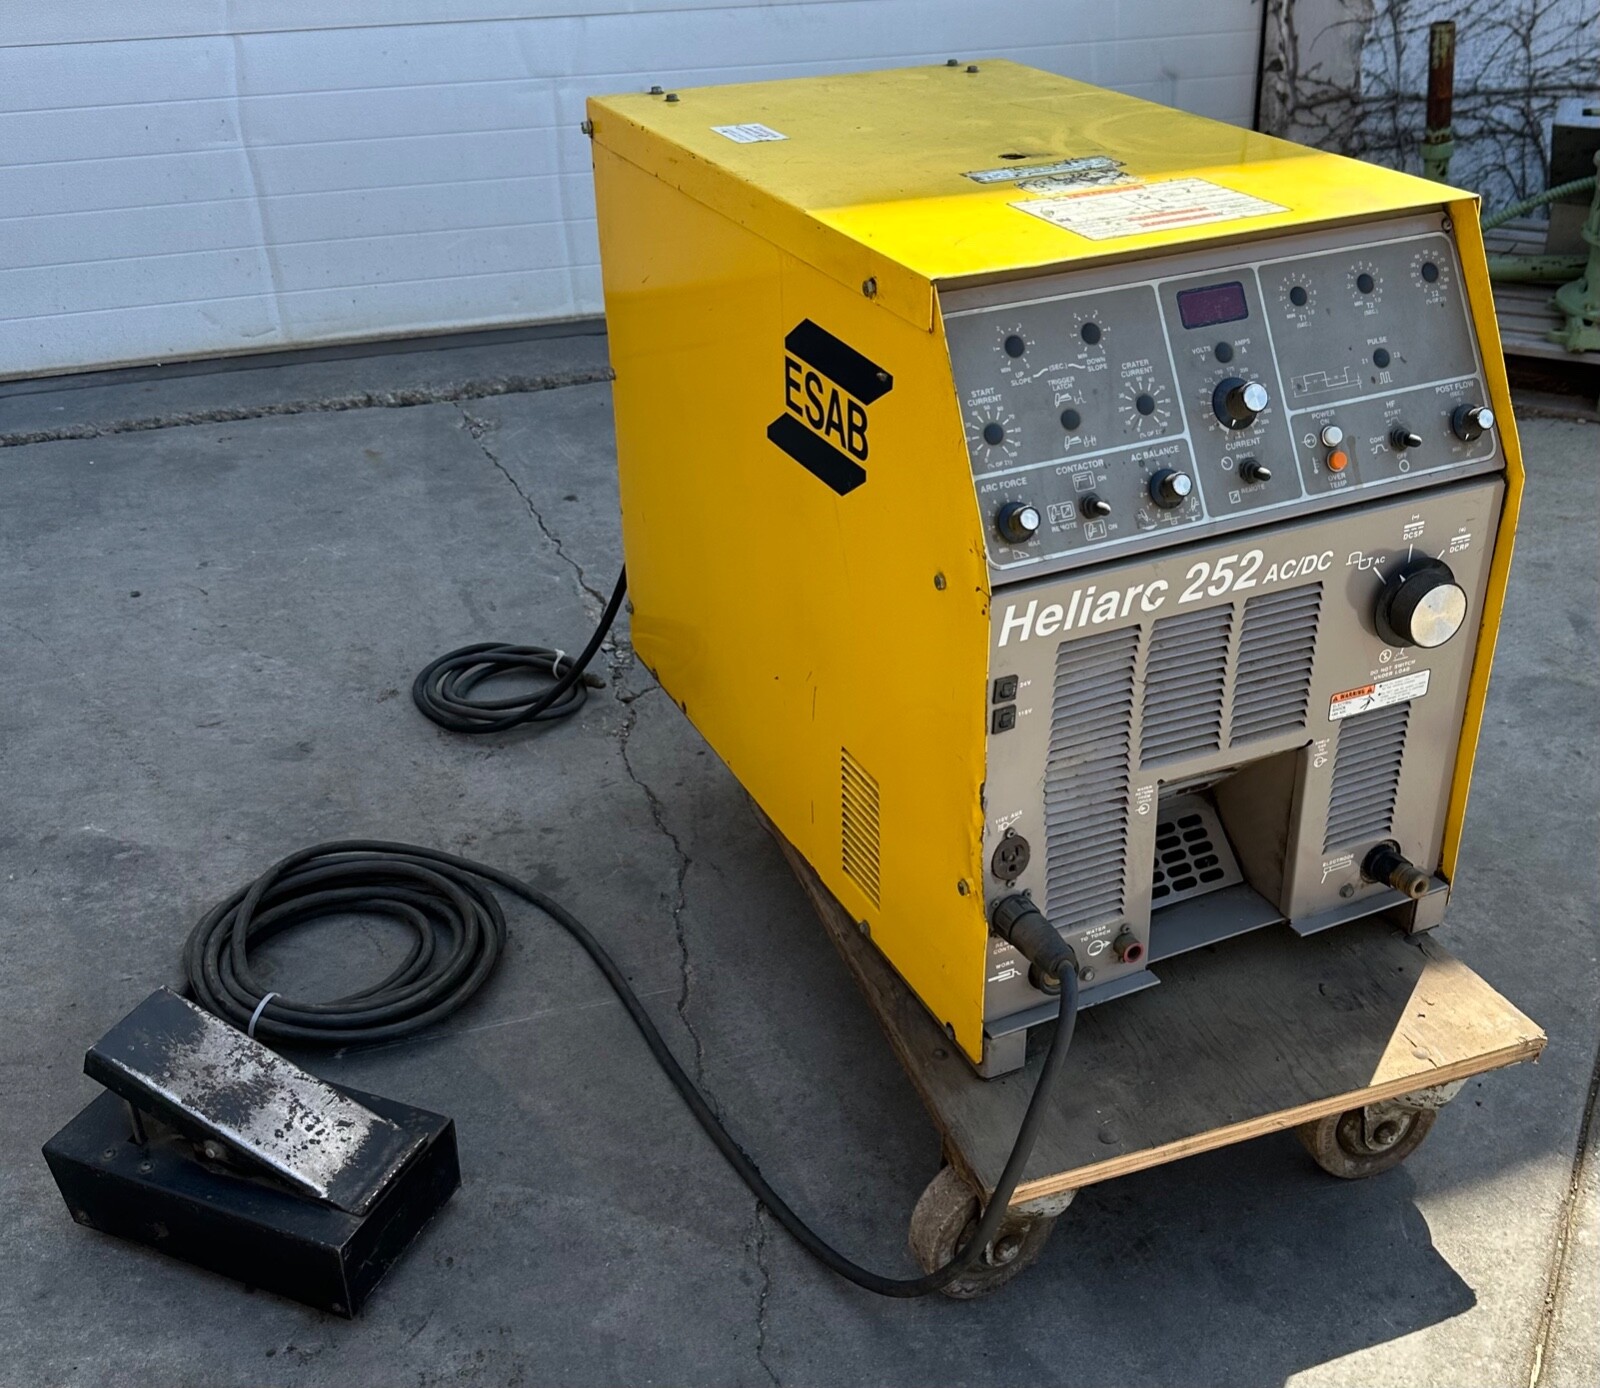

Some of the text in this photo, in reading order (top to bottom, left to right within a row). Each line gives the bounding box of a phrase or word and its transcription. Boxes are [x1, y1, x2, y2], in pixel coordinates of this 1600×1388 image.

[1234, 338, 1251, 346] AMPS
[1367, 336, 1388, 345] PULSE
[1192, 346, 1212, 354] VOLTS
[1086, 356, 1106, 366] DOWN
[1121, 359, 1150, 370] CRATER
[1087, 364, 1108, 372] SLOPE
[1120, 366, 1154, 378] CURRENT
[1010, 377, 1032, 386] SLOPE
[1048, 376, 1076, 386] TRIGGER
[1052, 382, 1073, 392] LATCH
[1435, 380, 1474, 394] POST FLOW
[971, 387, 995, 398] START
[968, 394, 1002, 407] CURRENT
[1386, 400, 1396, 408] HF
[784, 354, 870, 462] ESAB
[1384, 408, 1402, 418] START
[1312, 409, 1336, 420] POWER
[1226, 437, 1261, 451] CURRENT
[1370, 435, 1384, 444] CONT
[1131, 445, 1180, 462] AC BALANCE
[1236, 451, 1256, 460] PANEL
[1056, 458, 1104, 476] CONTACTOR
[1328, 472, 1346, 482] OVER
[980, 477, 1028, 494] ARC FORCE
[1241, 484, 1266, 494] REMOTE
[1330, 479, 1348, 489] TEMP
[1108, 523, 1118, 531] ON
[1403, 529, 1424, 540] DCSP
[1450, 542, 1470, 554] DCRP
[1374, 556, 1386, 564] AC
[998, 549, 1335, 648] Heliarc 252 AC/DC
[1380, 665, 1392, 673] NOT
[1394, 659, 1416, 670] SWITCH
[1373, 666, 1411, 680] UNDER LOAD
[1086, 926, 1106, 936] WATER
[1091, 929, 1110, 940] TORCH
[996, 960, 1014, 969] WORK
